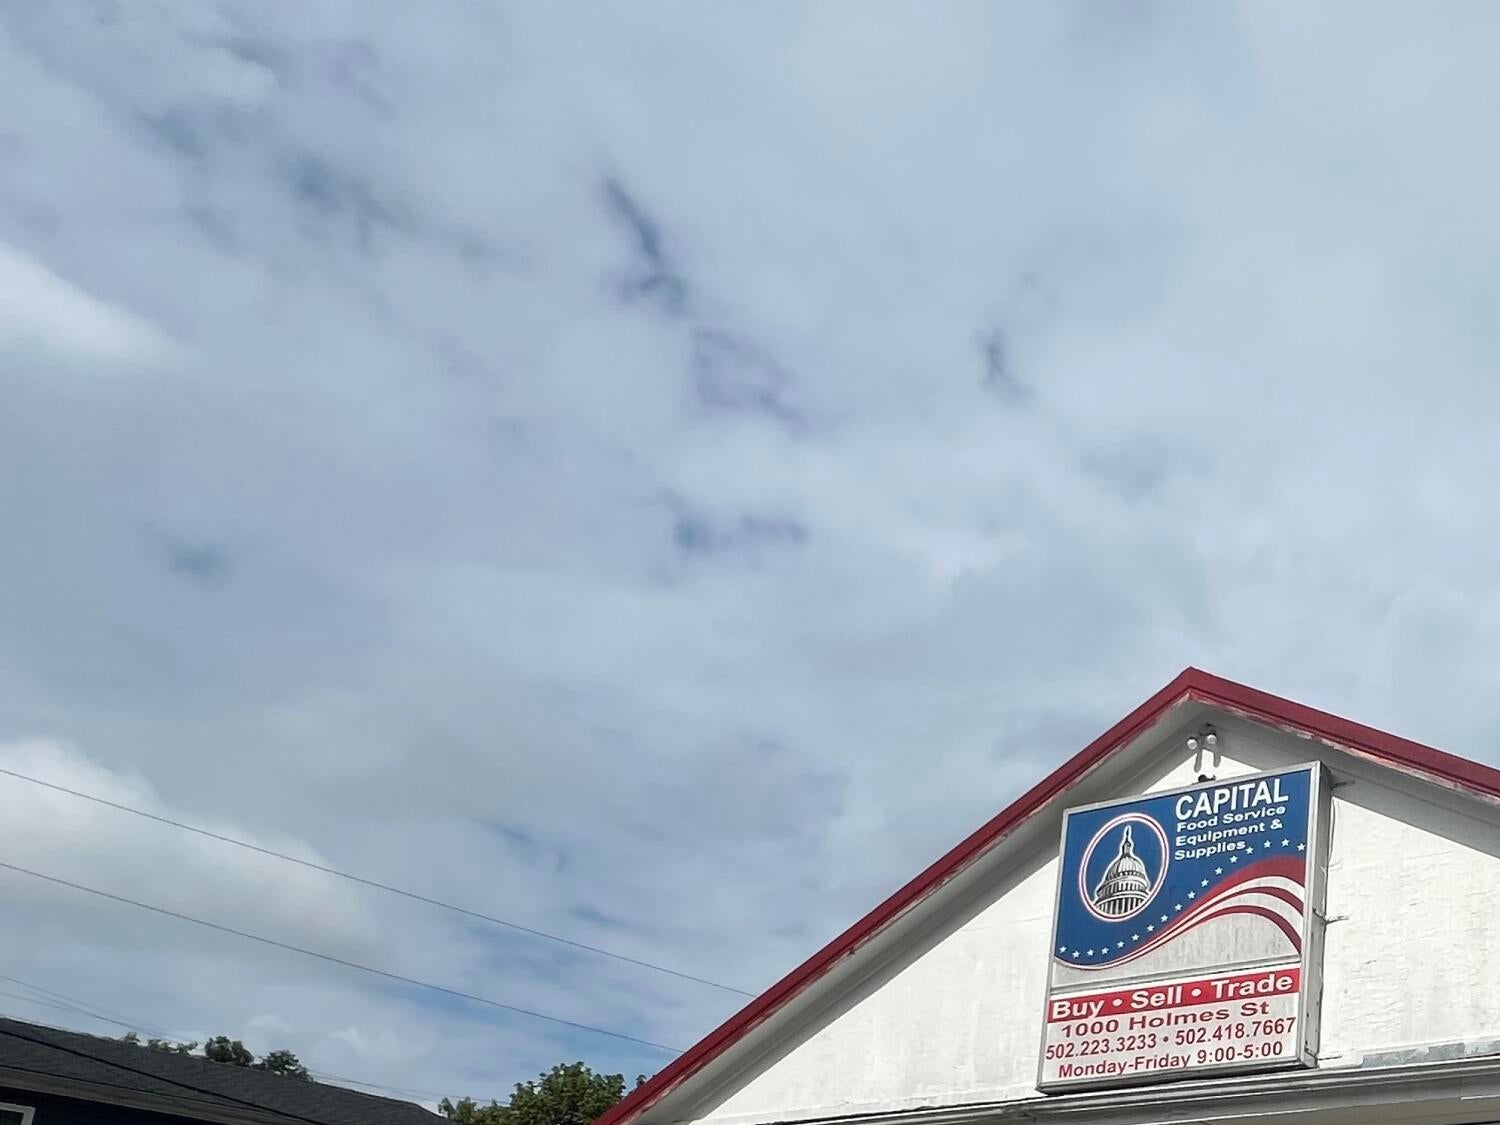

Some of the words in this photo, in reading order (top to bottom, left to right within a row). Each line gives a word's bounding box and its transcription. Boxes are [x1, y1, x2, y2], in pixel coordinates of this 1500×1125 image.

[1175, 779, 1289, 820] CAPITAL
[1175, 822, 1265, 846] Equipment
[1270, 819, 1283, 830] &
[1176, 816, 1218, 832] Food
[1222, 806, 1286, 824] Service
[1174, 840, 1246, 860] Supplies
[1052, 1000, 1105, 1019] Buy
[1130, 985, 1183, 1009] Sell
[1211, 973, 1293, 999] Trade
[1062, 1019, 1119, 1038] 1000
[1129, 1009, 1230, 1030] Holmes
[1240, 1001, 1269, 1017] St
[1046, 1033, 1157, 1060] 502.223.3233
[1175, 1017, 1296, 1045] 502.418.7667
[1058, 1053, 1191, 1078] Monday-Friday
[1197, 1041, 1283, 1064] 9:00-5:00
